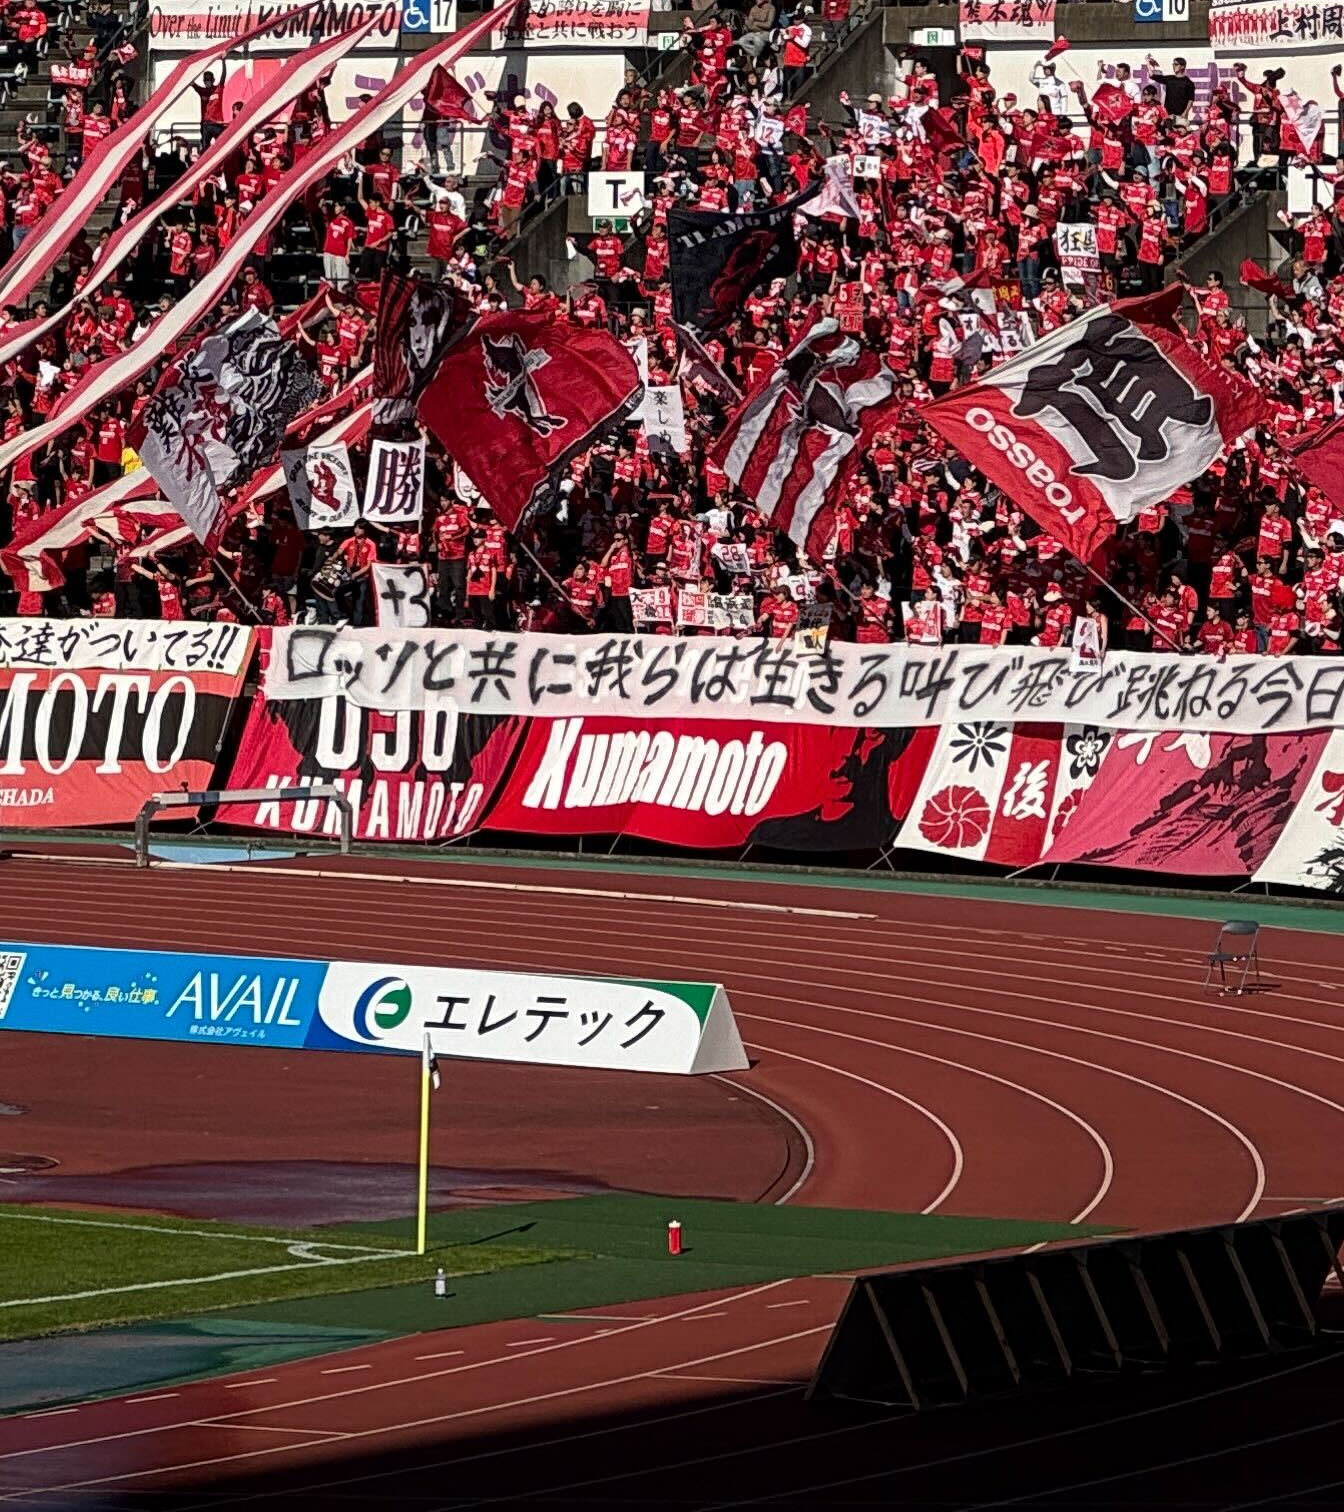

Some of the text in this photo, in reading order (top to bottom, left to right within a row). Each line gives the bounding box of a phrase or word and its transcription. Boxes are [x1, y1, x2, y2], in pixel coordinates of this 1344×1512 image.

[150, 8, 183, 41] Over
[187, 20, 202, 36] the
[257, 2, 396, 39] KUMAMOTO
[605, 179, 626, 209] T
[366, 445, 421, 516] 勝
[964, 406, 1086, 525] roasso
[253, 772, 485, 842] KUMAMOTO
[1002, 762, 1048, 822] 後
[166, 970, 302, 1027] AVAIL
[422, 993, 667, 1050] エレテック
